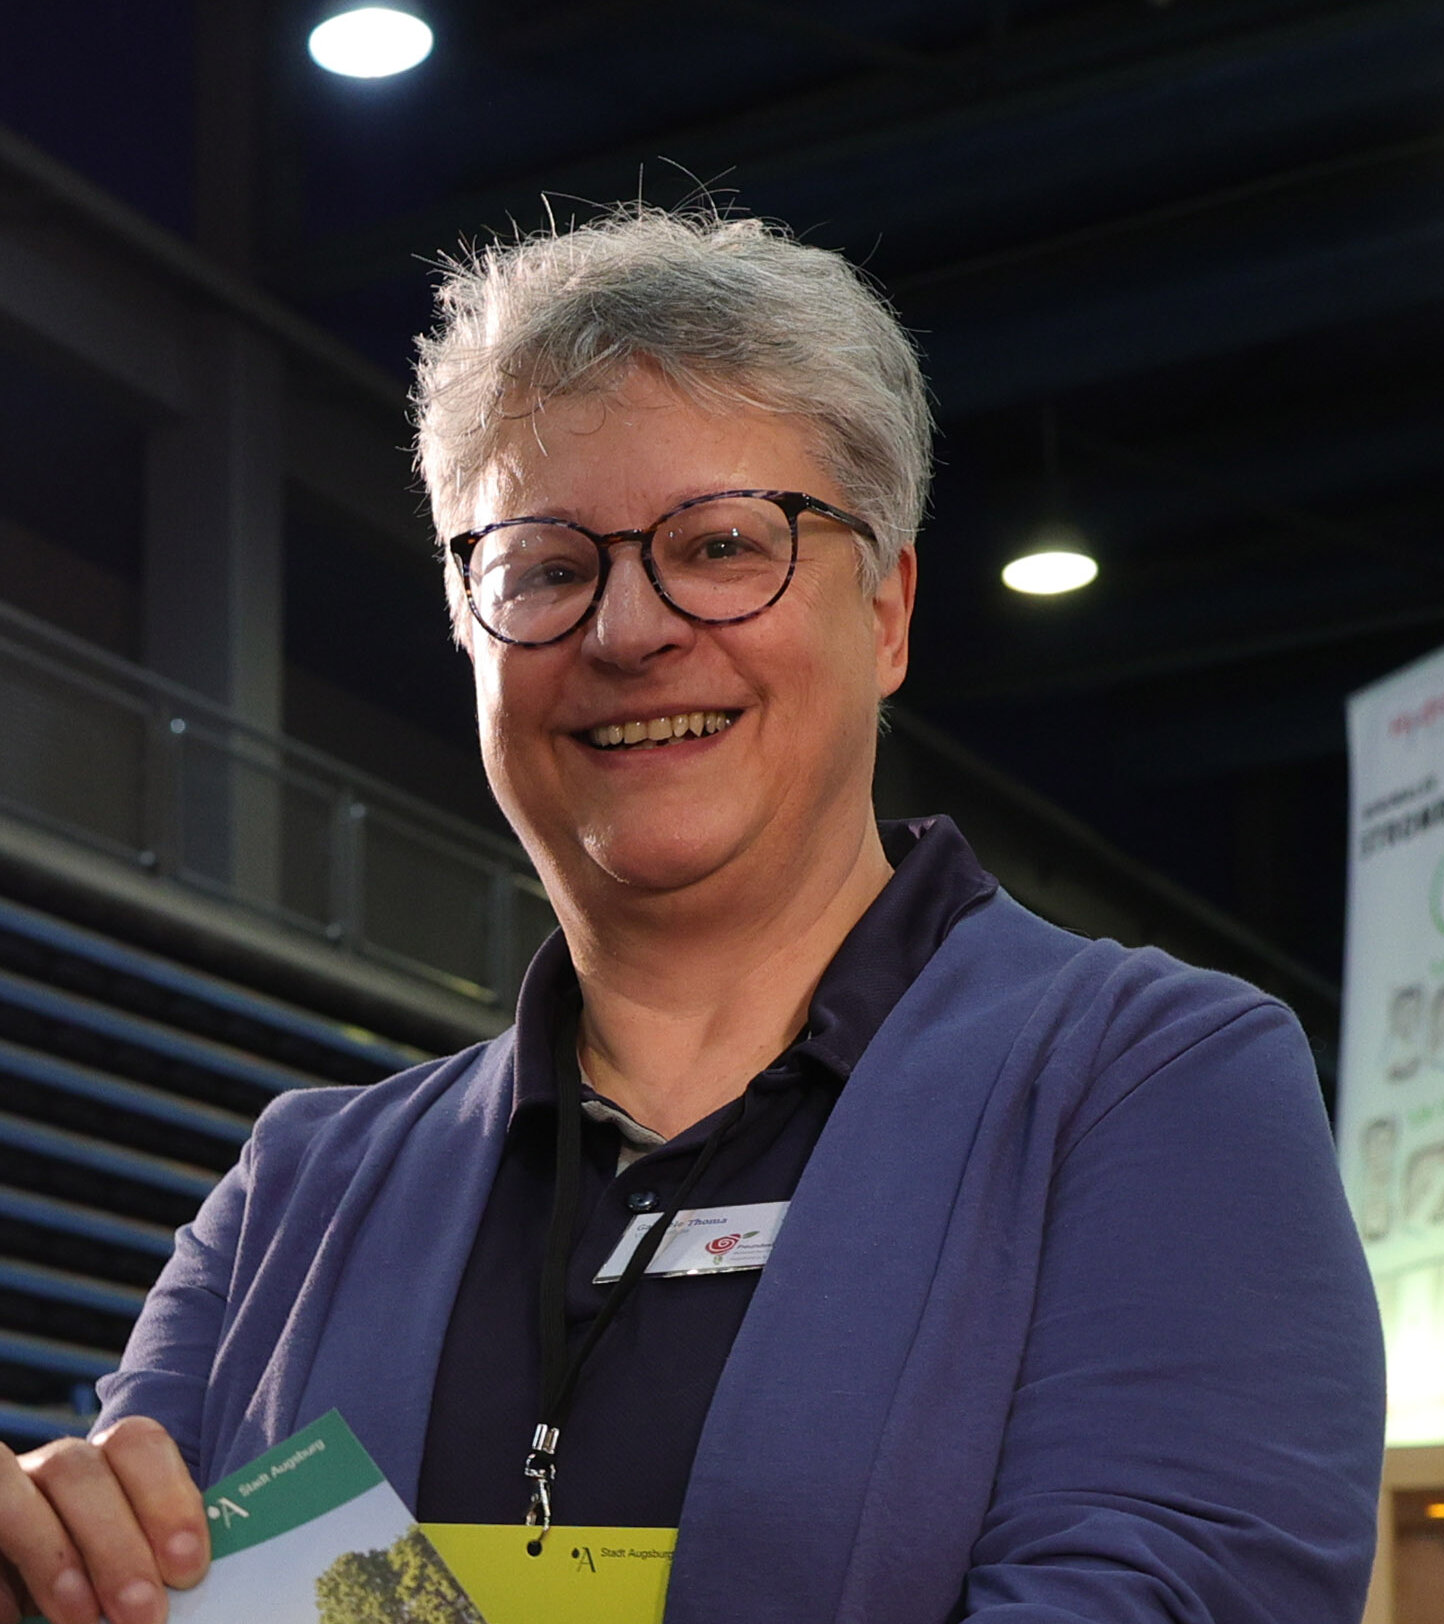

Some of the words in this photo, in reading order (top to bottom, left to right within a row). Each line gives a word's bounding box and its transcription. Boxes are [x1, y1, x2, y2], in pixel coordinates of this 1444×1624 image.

[688, 1217, 728, 1228] Thoma
[238, 1474, 271, 1498] Stadt
[271, 1439, 326, 1478] Augsburg
[601, 1547, 626, 1558] Stadt
[628, 1549, 674, 1561] Augsburg
